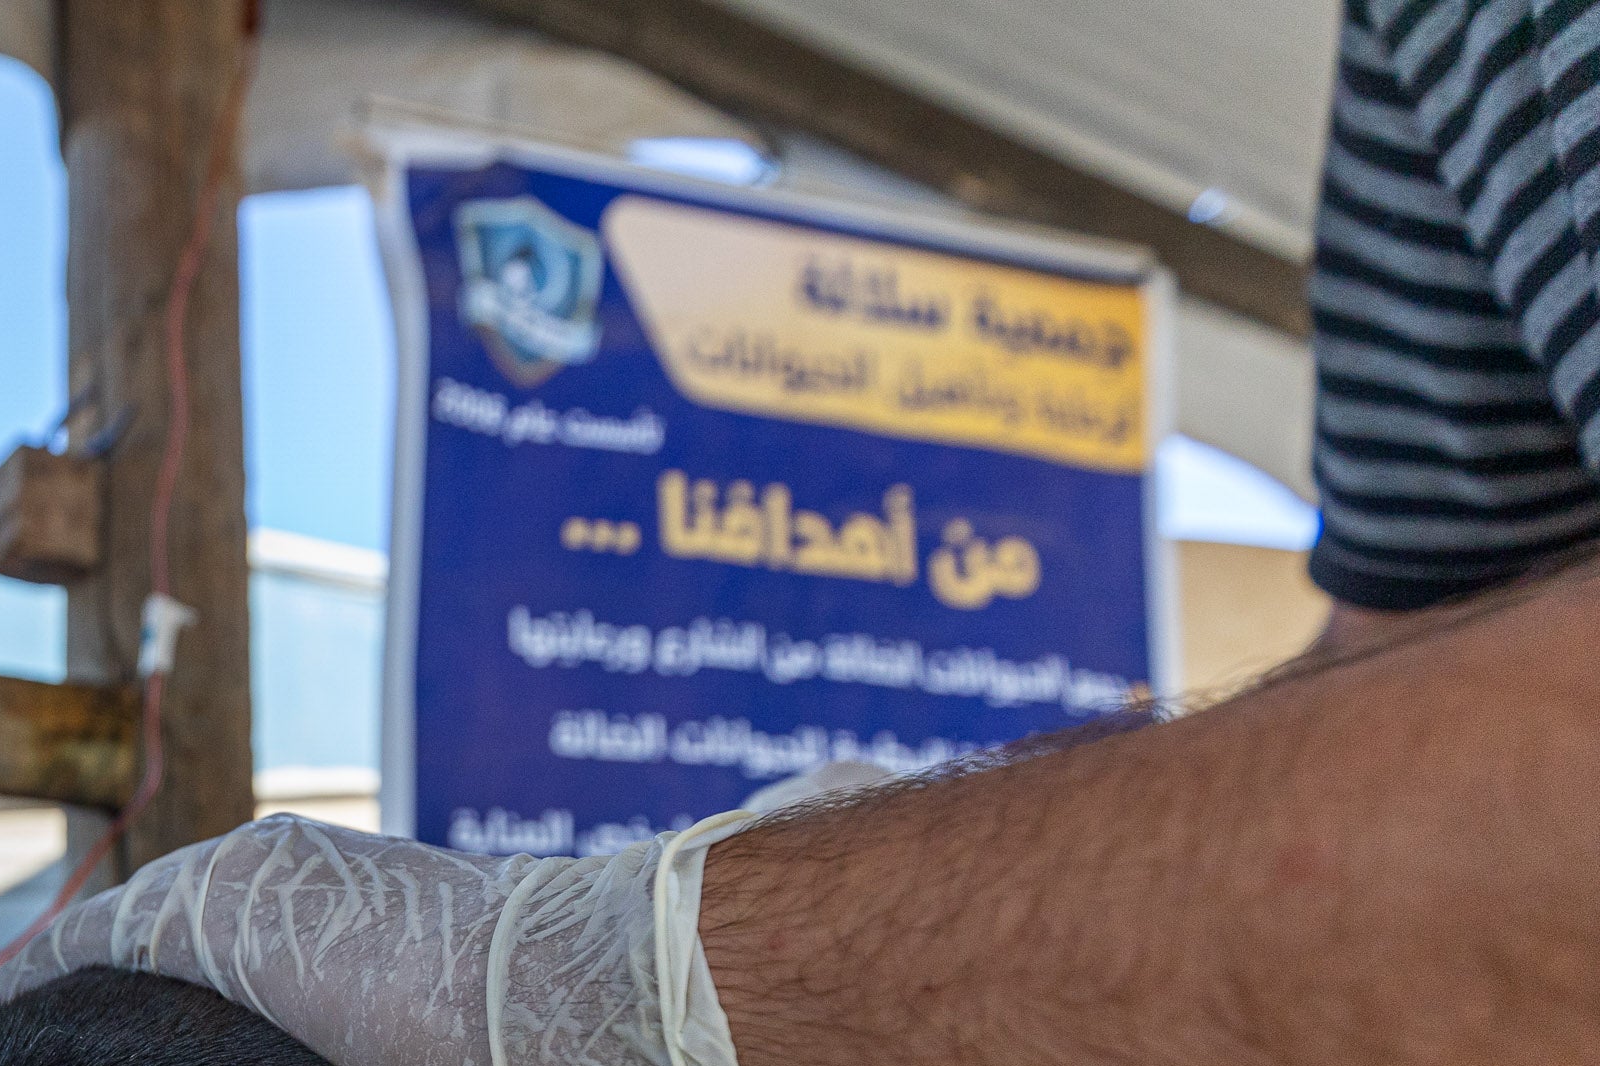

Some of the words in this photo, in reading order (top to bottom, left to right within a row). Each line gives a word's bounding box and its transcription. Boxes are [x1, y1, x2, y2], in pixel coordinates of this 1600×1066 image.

[657, 468, 918, 587] أهدافنا
[928, 516, 1041, 610] من
[507, 604, 652, 674] ورعايتها
[653, 614, 766, 678] الشارع
[764, 631, 823, 685] من
[822, 632, 922, 691] الضالة
[549, 708, 668, 764] الضالة
